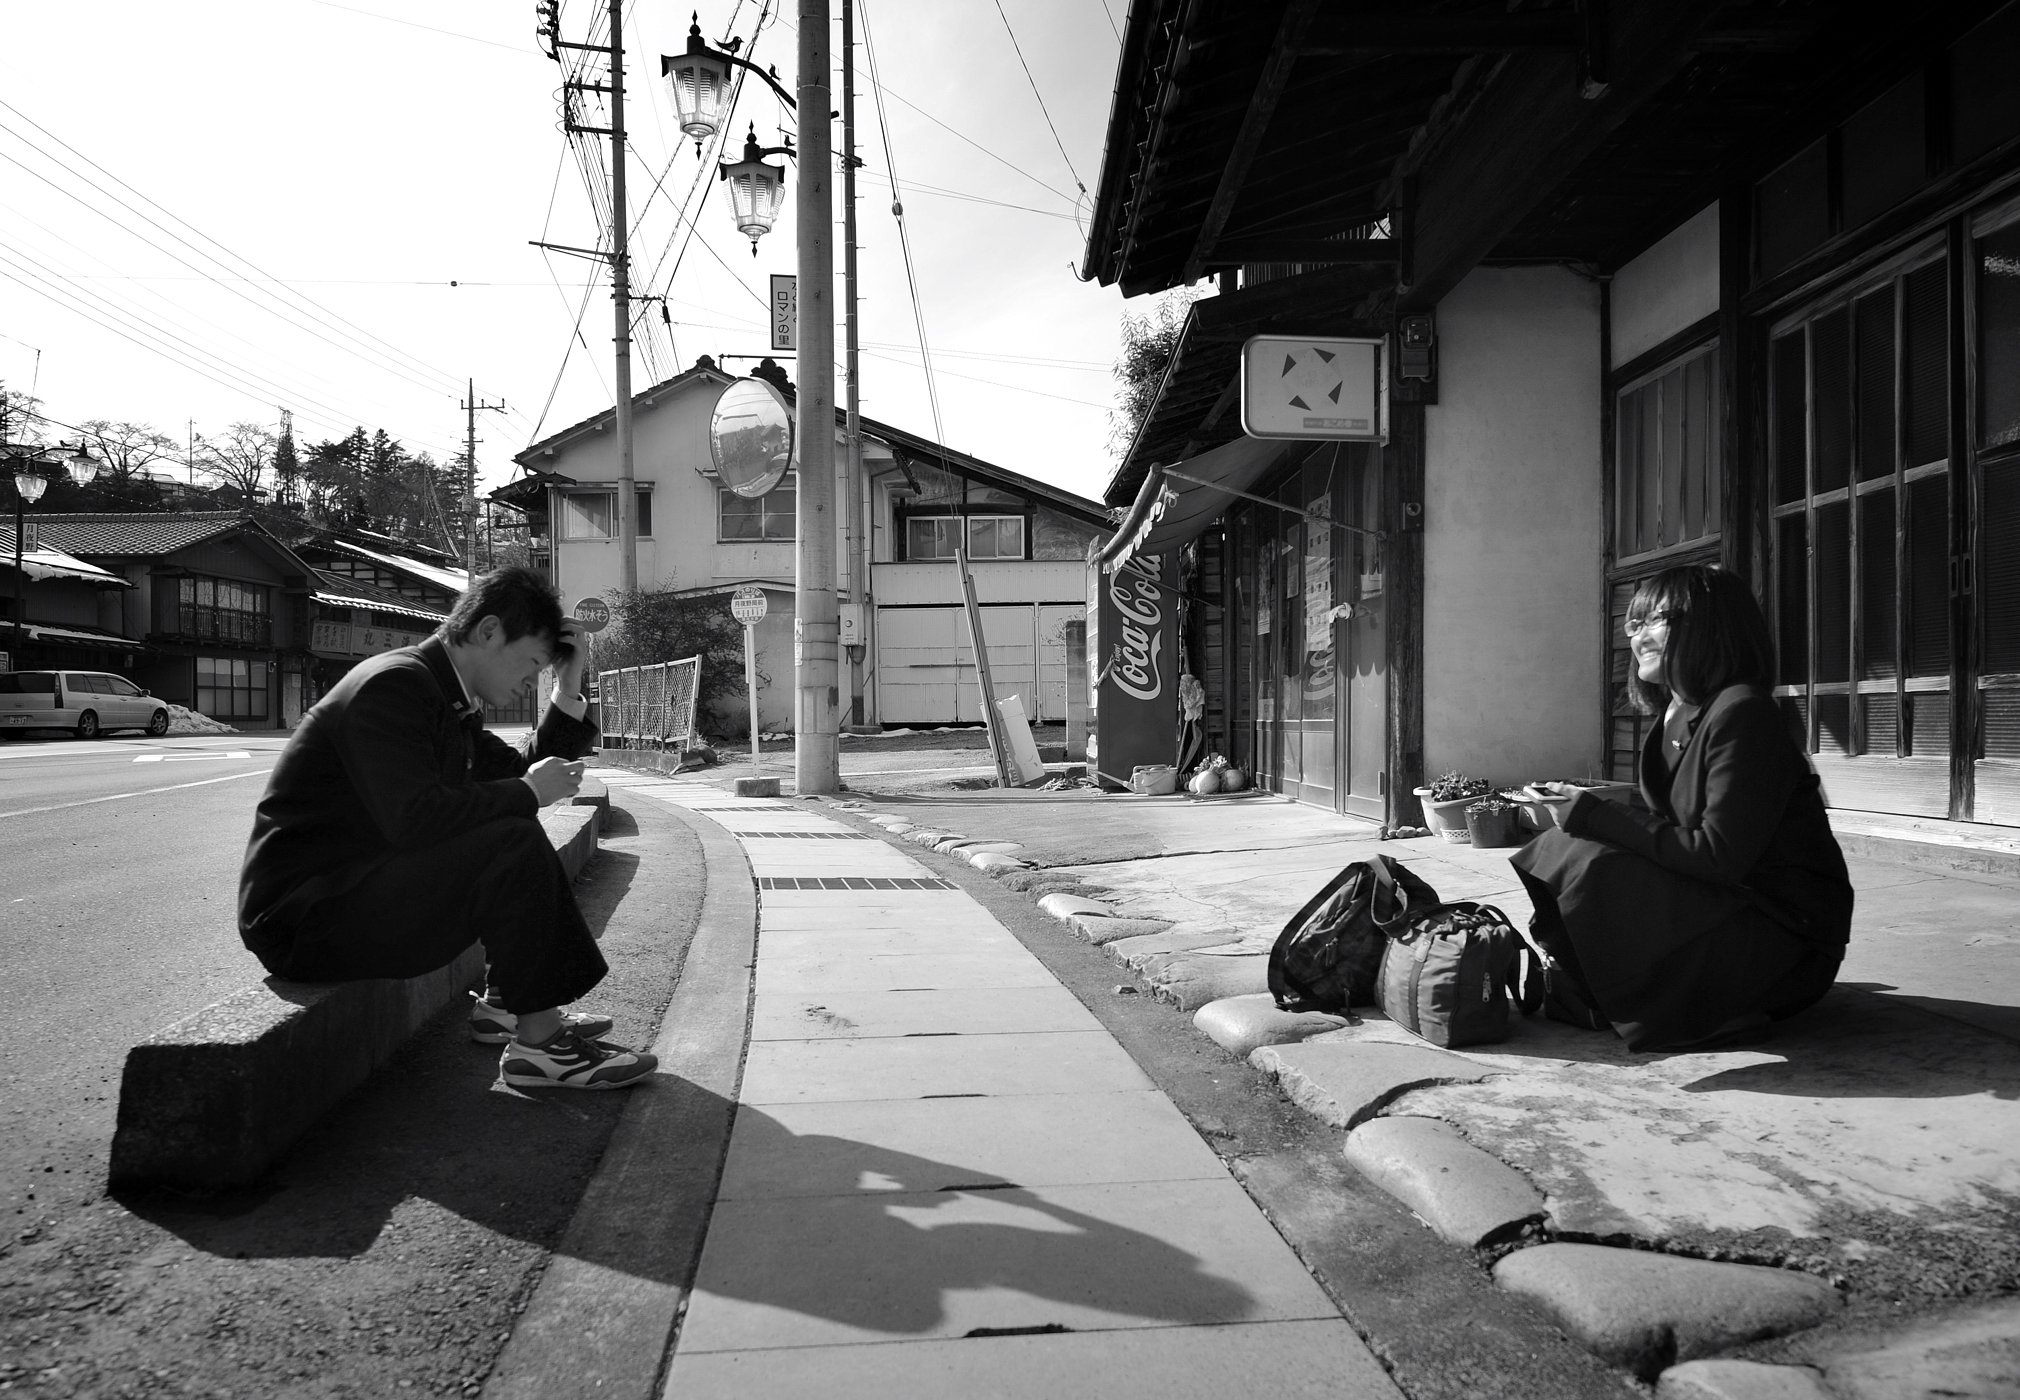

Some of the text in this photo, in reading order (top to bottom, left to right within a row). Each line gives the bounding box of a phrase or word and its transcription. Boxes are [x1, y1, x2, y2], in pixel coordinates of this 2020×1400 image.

[777, 291, 790, 346] ロマンの里
[1110, 555, 1162, 701] Coca-Cola
